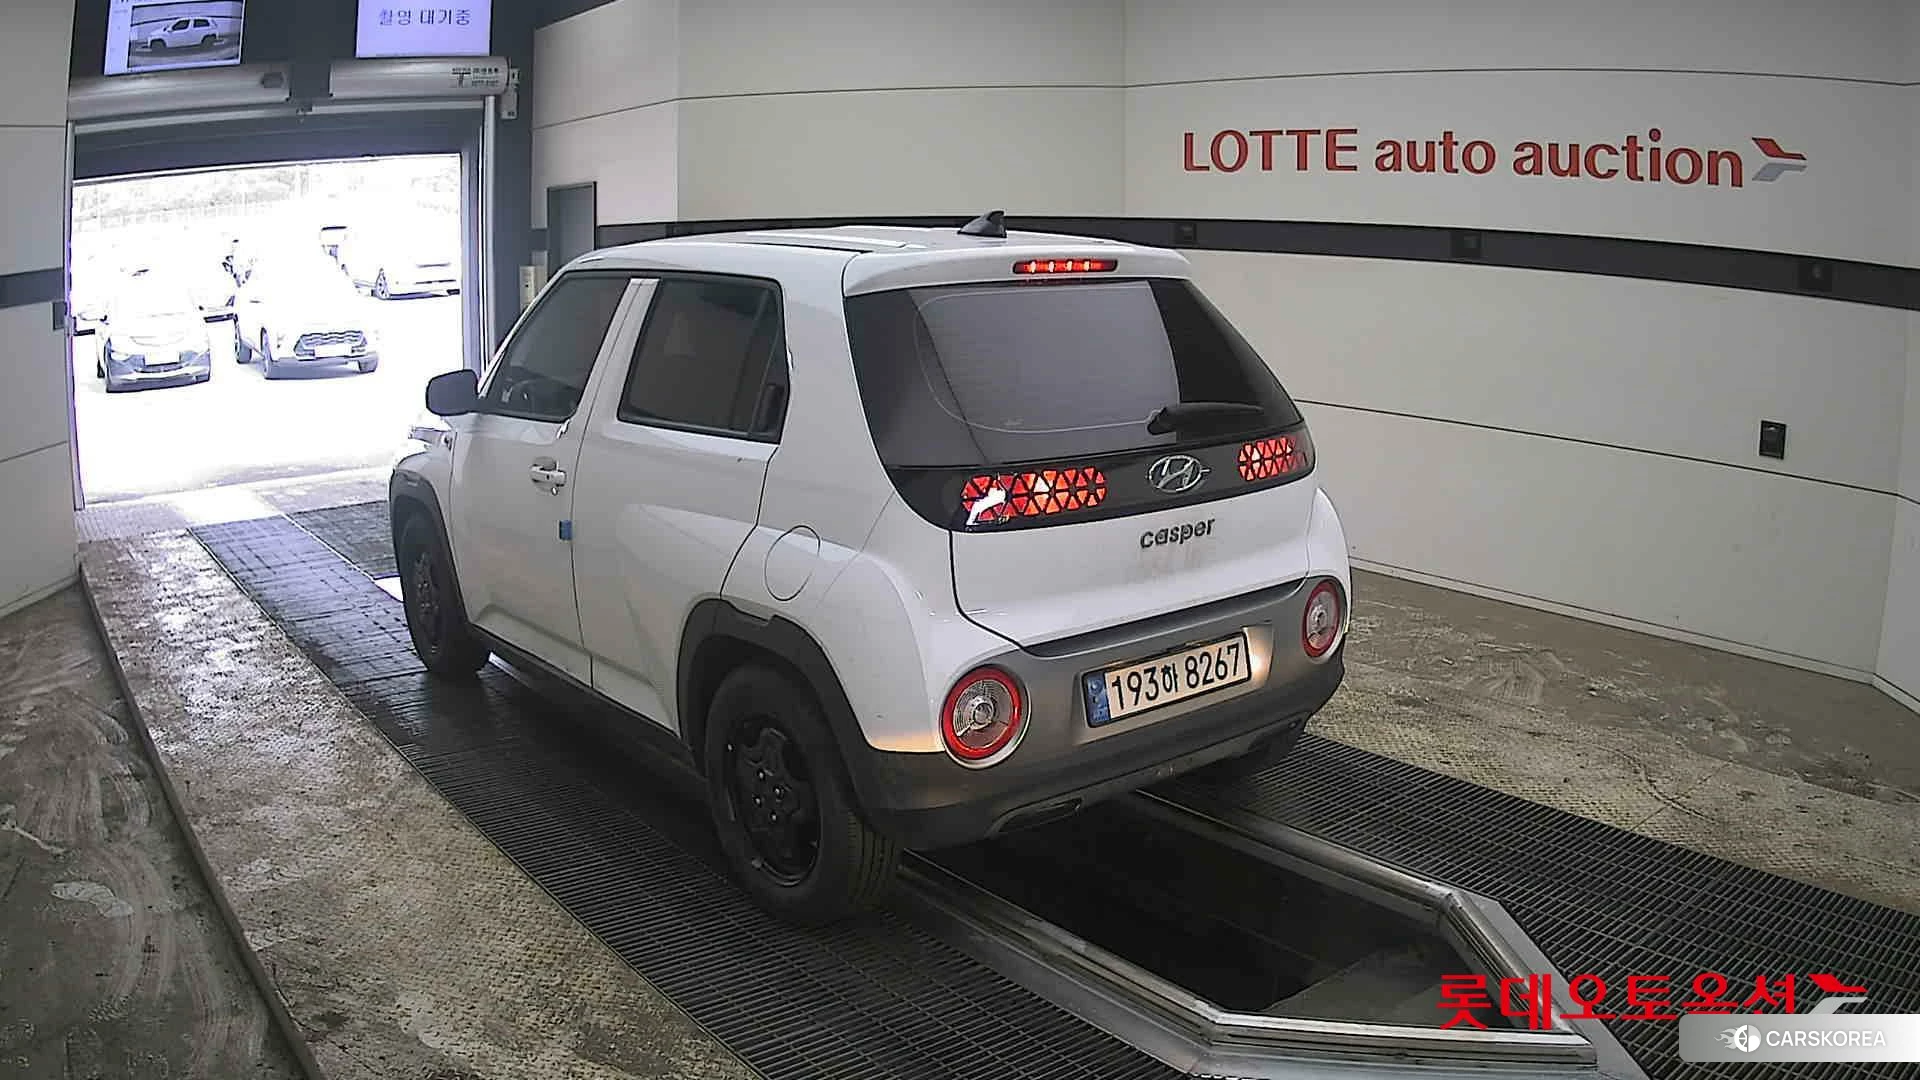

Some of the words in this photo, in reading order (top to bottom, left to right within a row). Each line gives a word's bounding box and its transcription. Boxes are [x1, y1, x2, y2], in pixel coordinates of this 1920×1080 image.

[420, 8, 471, 26] 대기중
[1183, 129, 1359, 172] LOTTE
[1374, 131, 1497, 175] auto
[1513, 129, 1745, 188] auction
[1140, 517, 1216, 549] casper
[1111, 663, 1179, 710] 193하
[1184, 643, 1240, 690] 8267
